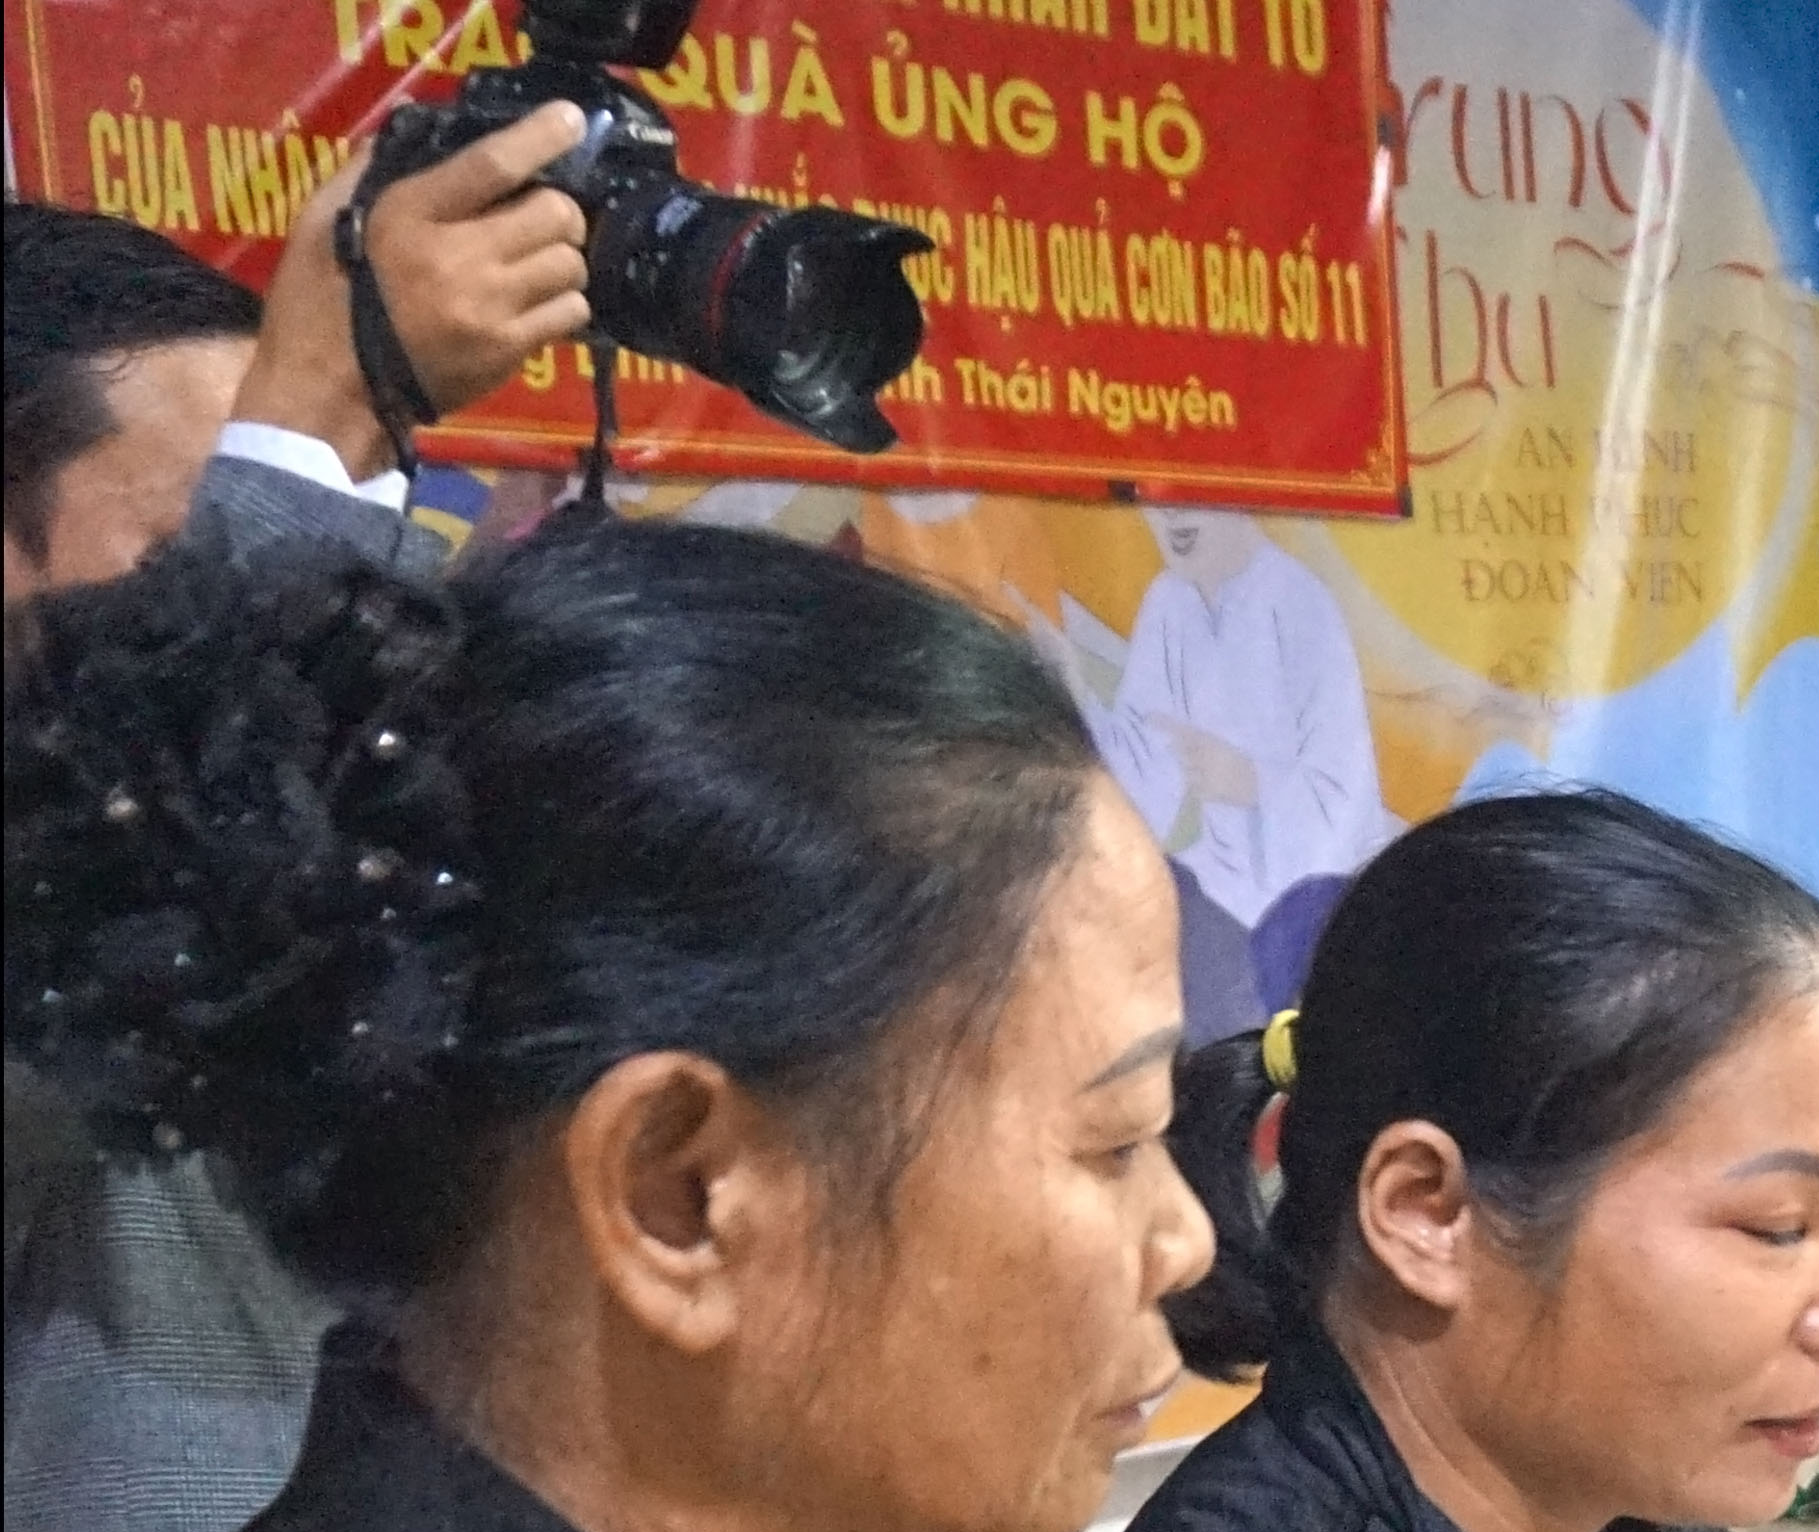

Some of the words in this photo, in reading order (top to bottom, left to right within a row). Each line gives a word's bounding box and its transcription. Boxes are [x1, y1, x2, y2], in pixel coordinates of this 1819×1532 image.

[88, 73, 200, 231] CỦA
[334, 0, 534, 75] TRA
[871, 29, 1059, 157] ỦNG
[1085, 82, 1205, 200] HỘ
[964, 194, 1041, 332] HẬU
[1047, 196, 1121, 331] QUẢ
[1126, 227, 1198, 329] CƠN
[1203, 226, 1269, 338] BÃO
[1278, 222, 1320, 342] SỐ
[1325, 260, 1368, 347] 11
[953, 357, 1052, 416] Thái
[1066, 366, 1238, 435] Nguyên
